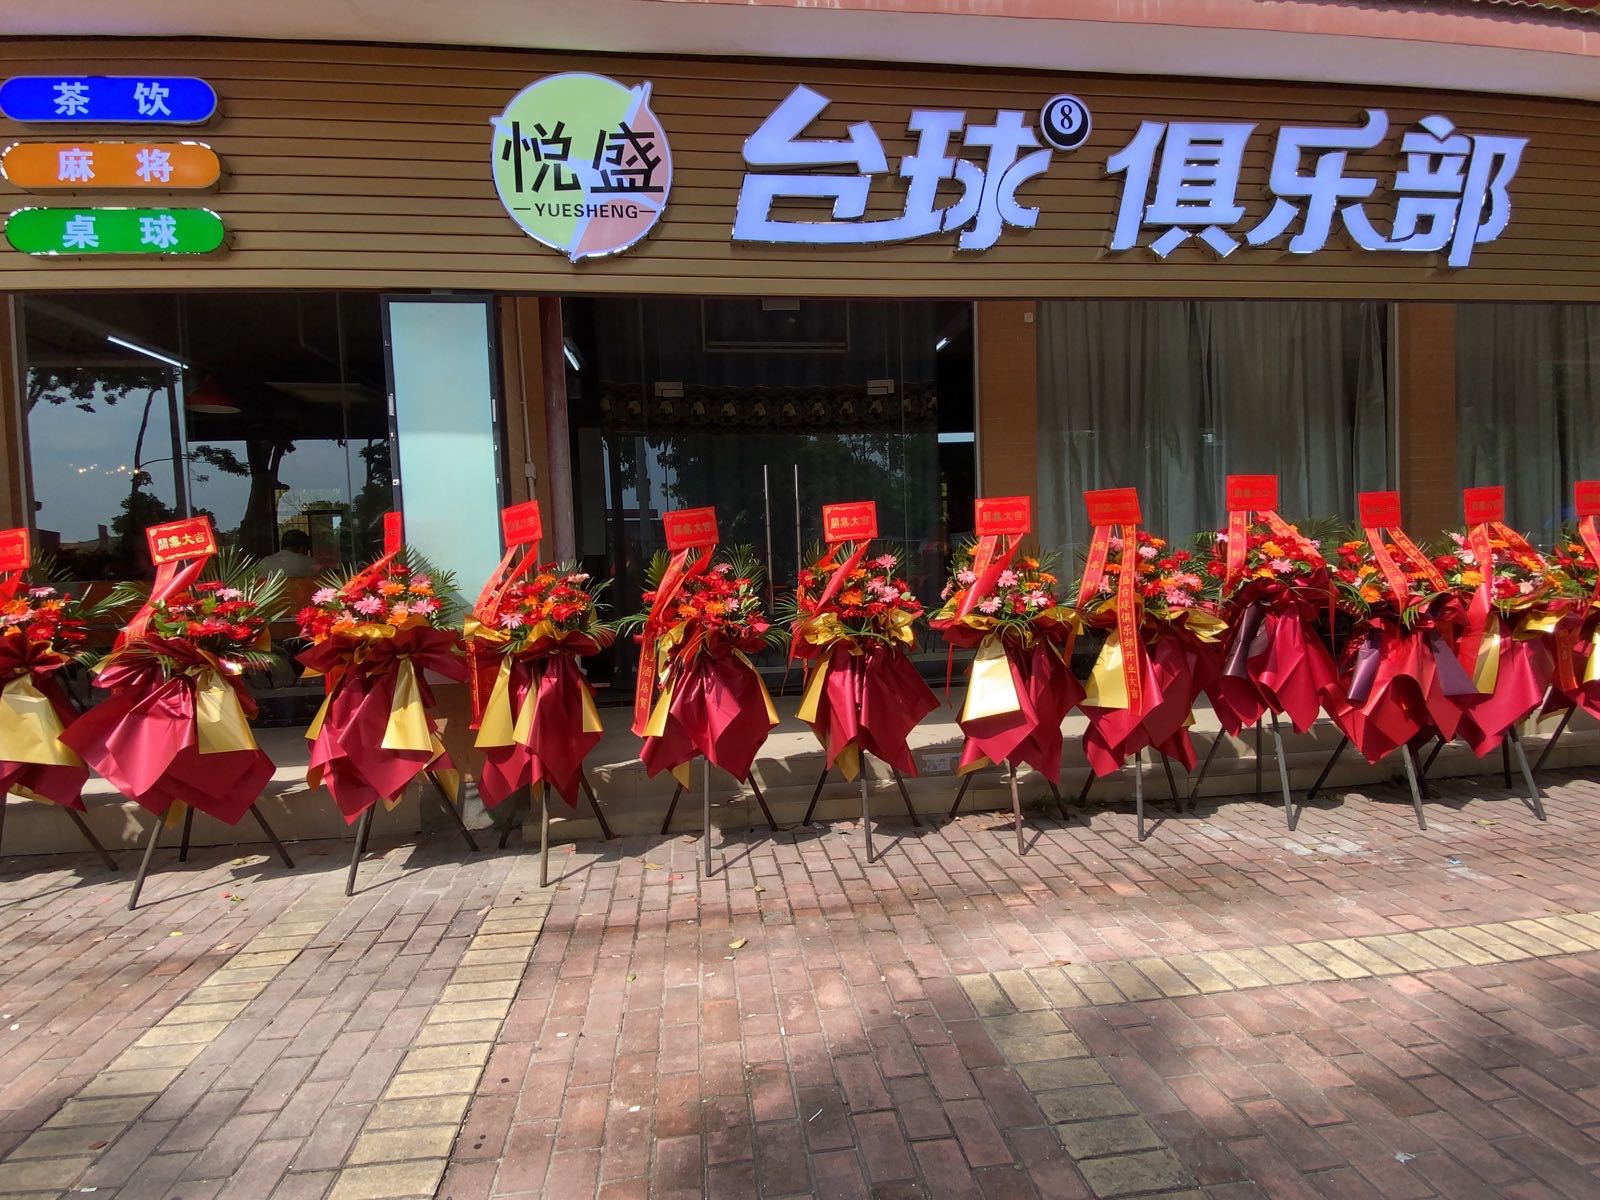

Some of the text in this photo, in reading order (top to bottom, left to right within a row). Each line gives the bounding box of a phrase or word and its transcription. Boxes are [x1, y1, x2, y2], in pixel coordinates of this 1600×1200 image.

[53, 82, 172, 116] 茶饮
[1060, 103, 1074, 130] 8
[58, 148, 173, 182] 麻将
[502, 120, 664, 194] 悦盛
[732, 83, 1530, 267] 台球俱乐部
[534, 203, 638, 219] YUESHENG
[62, 214, 178, 248] 桌球
